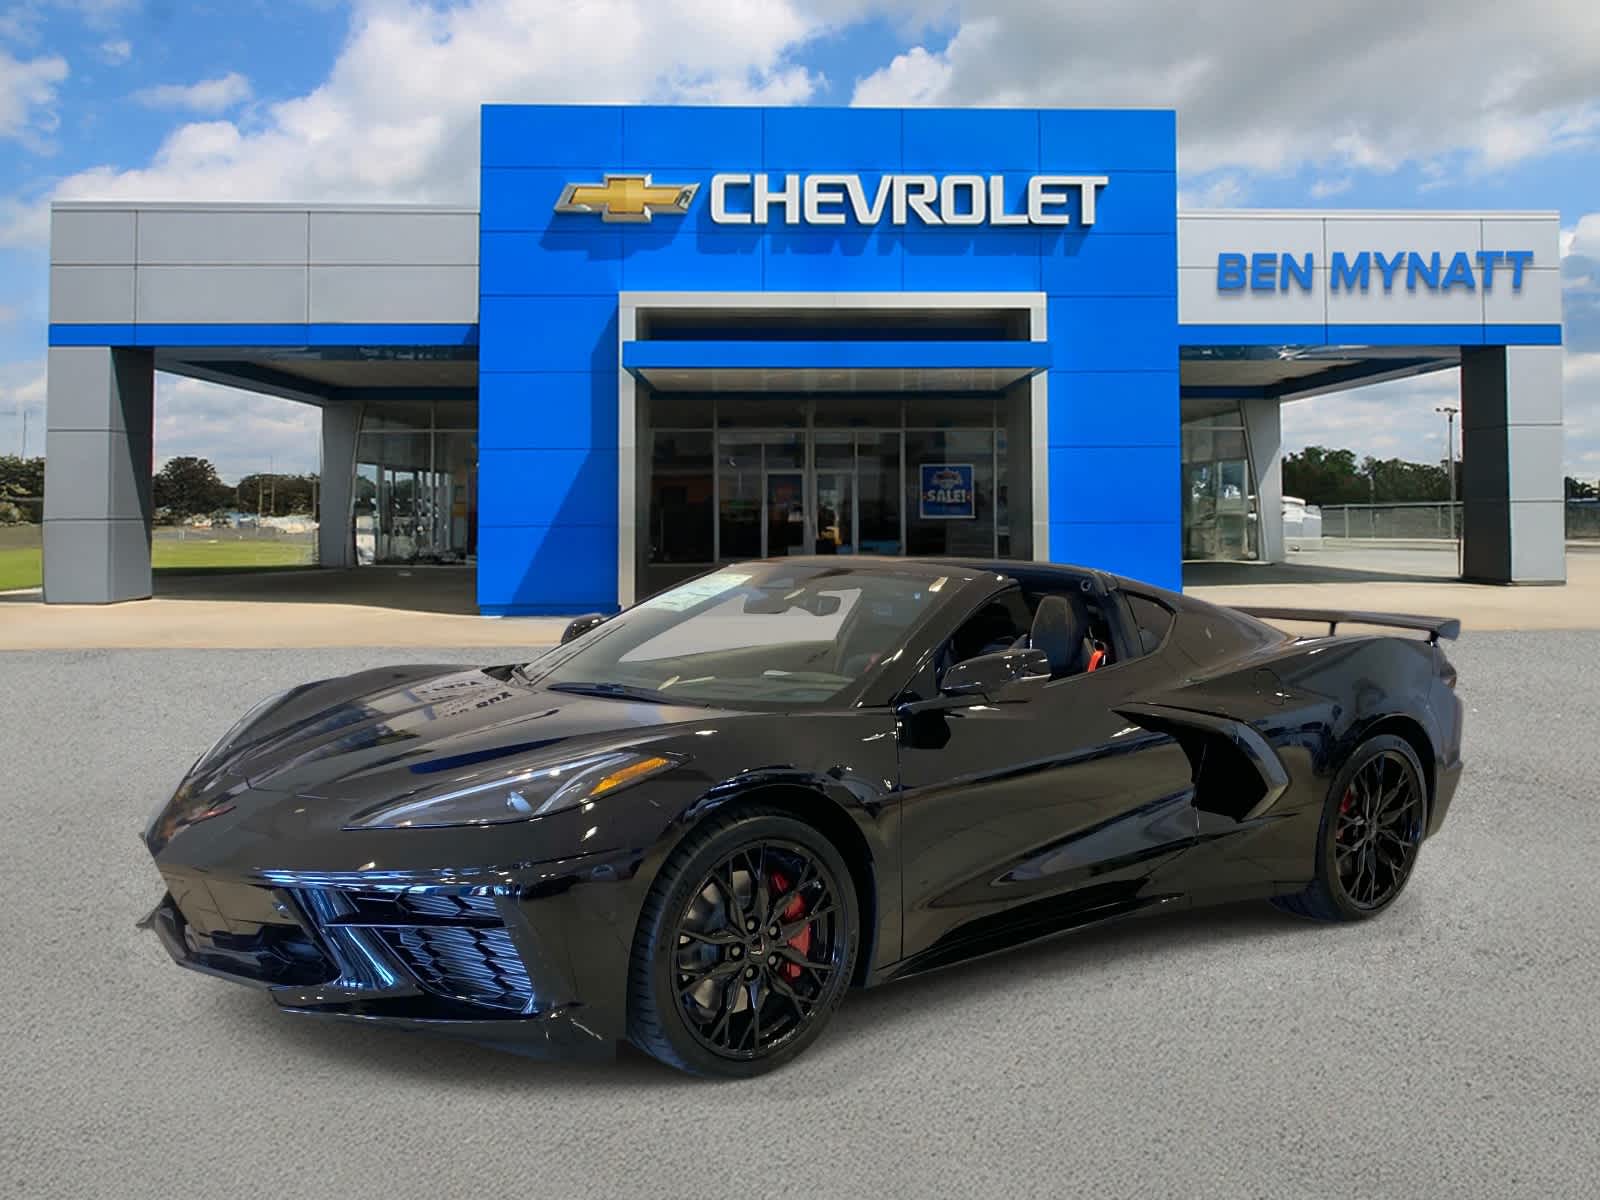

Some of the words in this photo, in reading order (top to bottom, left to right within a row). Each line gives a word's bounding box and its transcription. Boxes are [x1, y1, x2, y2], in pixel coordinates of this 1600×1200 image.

[711, 173, 1109, 224] CHEVROLET
[1217, 251, 1313, 289] BEN
[1330, 250, 1533, 289] MYNATT
